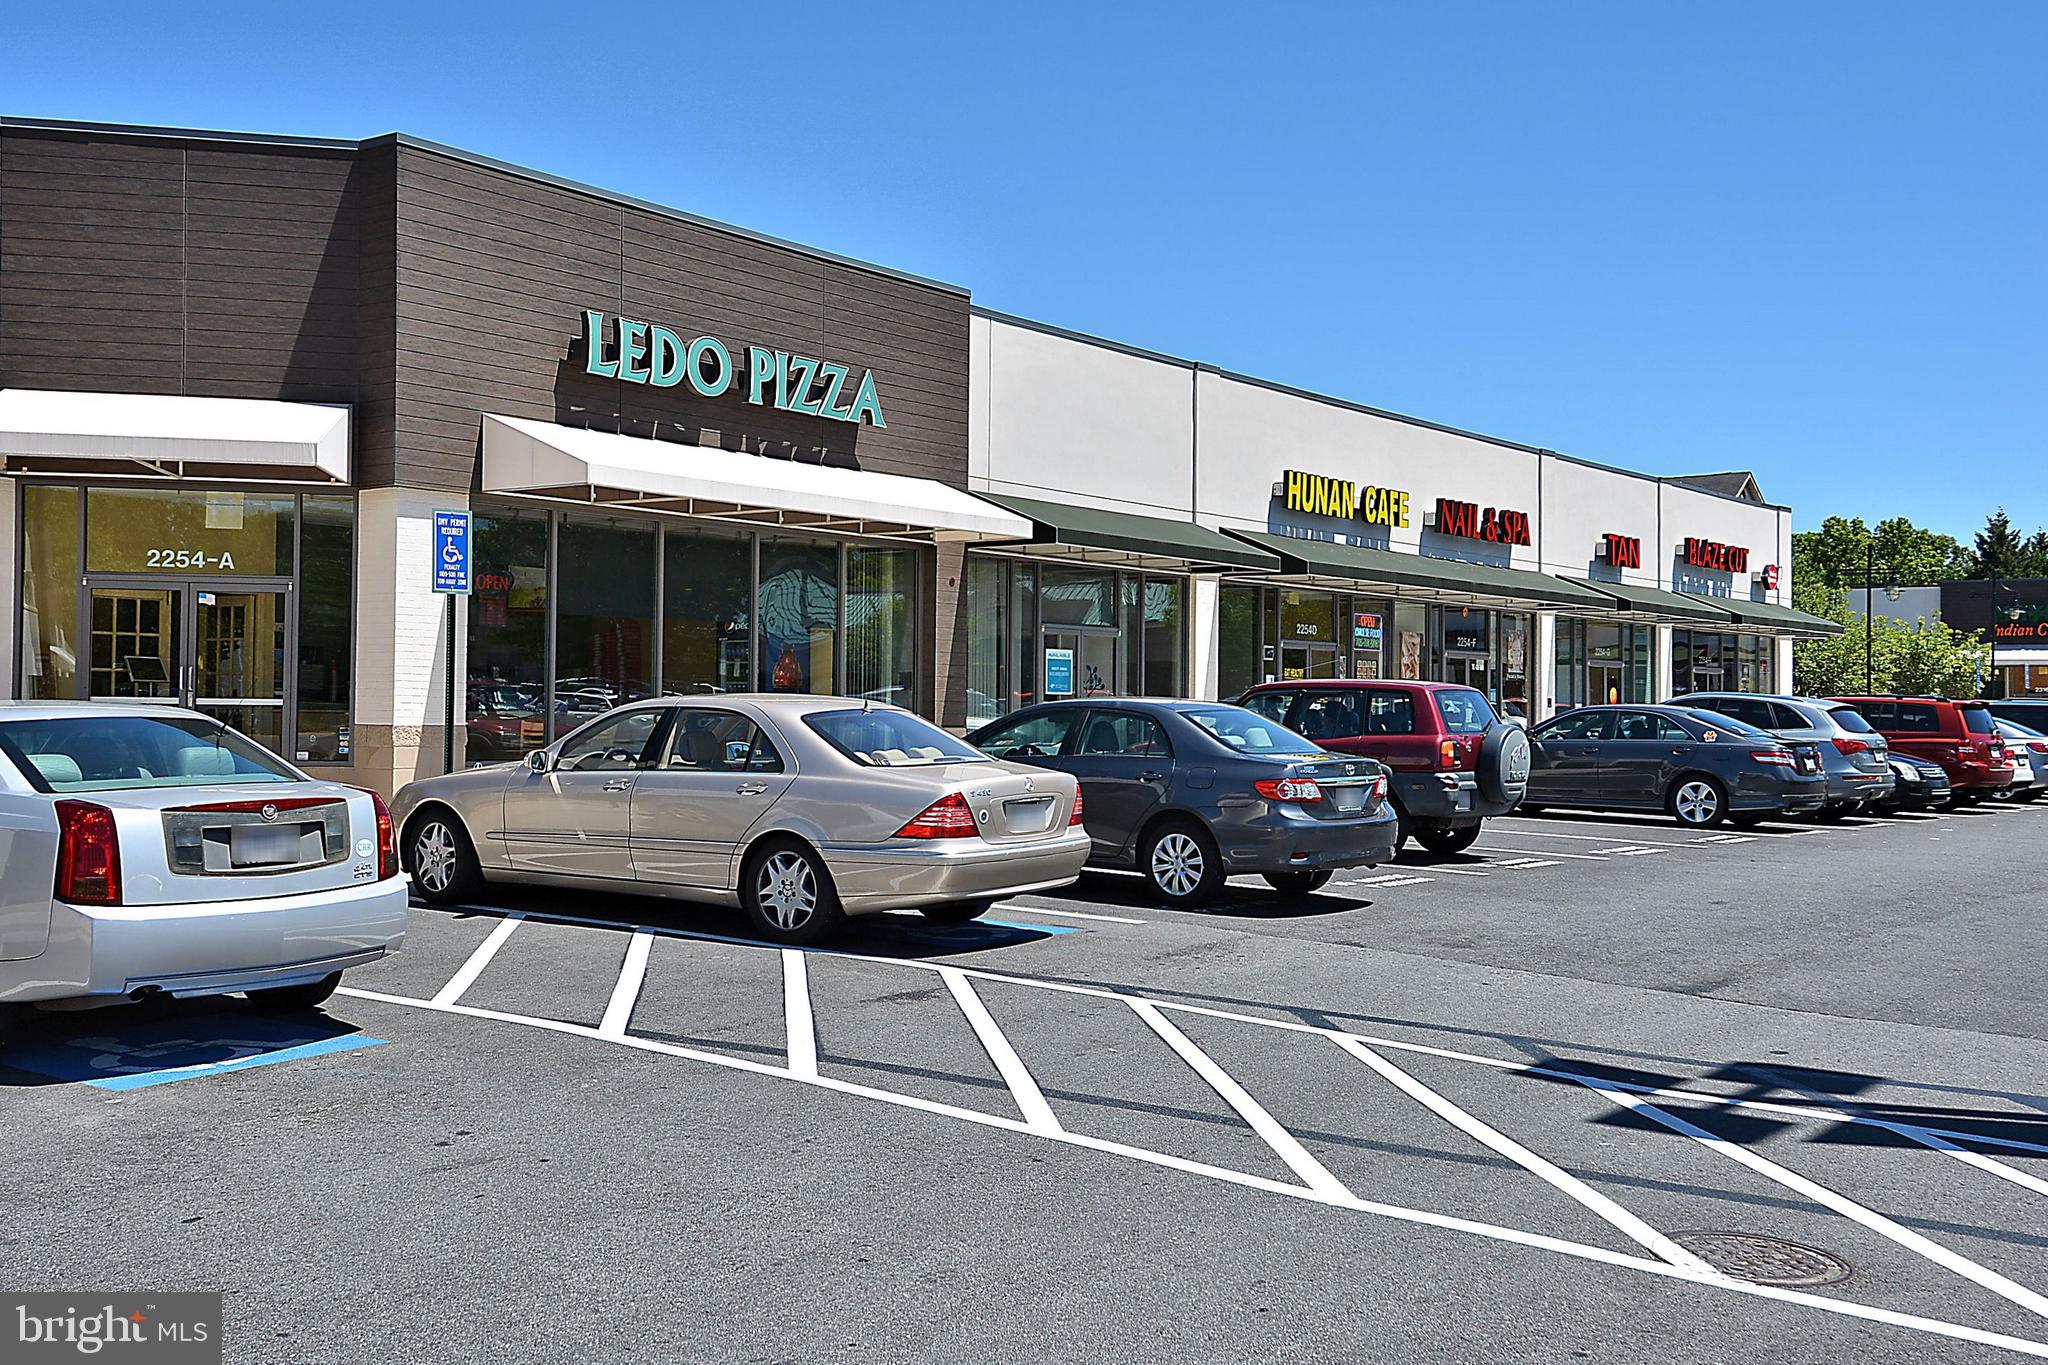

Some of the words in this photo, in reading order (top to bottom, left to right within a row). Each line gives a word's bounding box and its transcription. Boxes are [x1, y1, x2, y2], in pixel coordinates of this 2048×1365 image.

[586, 309, 733, 397] LEDO
[748, 345, 887, 428] PIZZA
[1287, 470, 1355, 520] HUNAN
[1365, 485, 1410, 528] CAFE
[441, 527, 463, 535] REQUIRED
[450, 519, 466, 527] PERMIT
[1440, 499, 1481, 539] NAIL
[1486, 508, 1500, 542] &
[1503, 510, 1531, 546] SPA
[146, 549, 235, 570] 2254-A
[1608, 534, 1640, 569] TAN
[1689, 538, 1725, 570] BLAZE
[1728, 545, 1749, 573] CUT
[475, 574, 510, 592] OPEN
[1296, 624, 1318, 635] 2254D
[1360, 616, 1376, 627] OPEN
[1456, 636, 1477, 648] 2254-F
